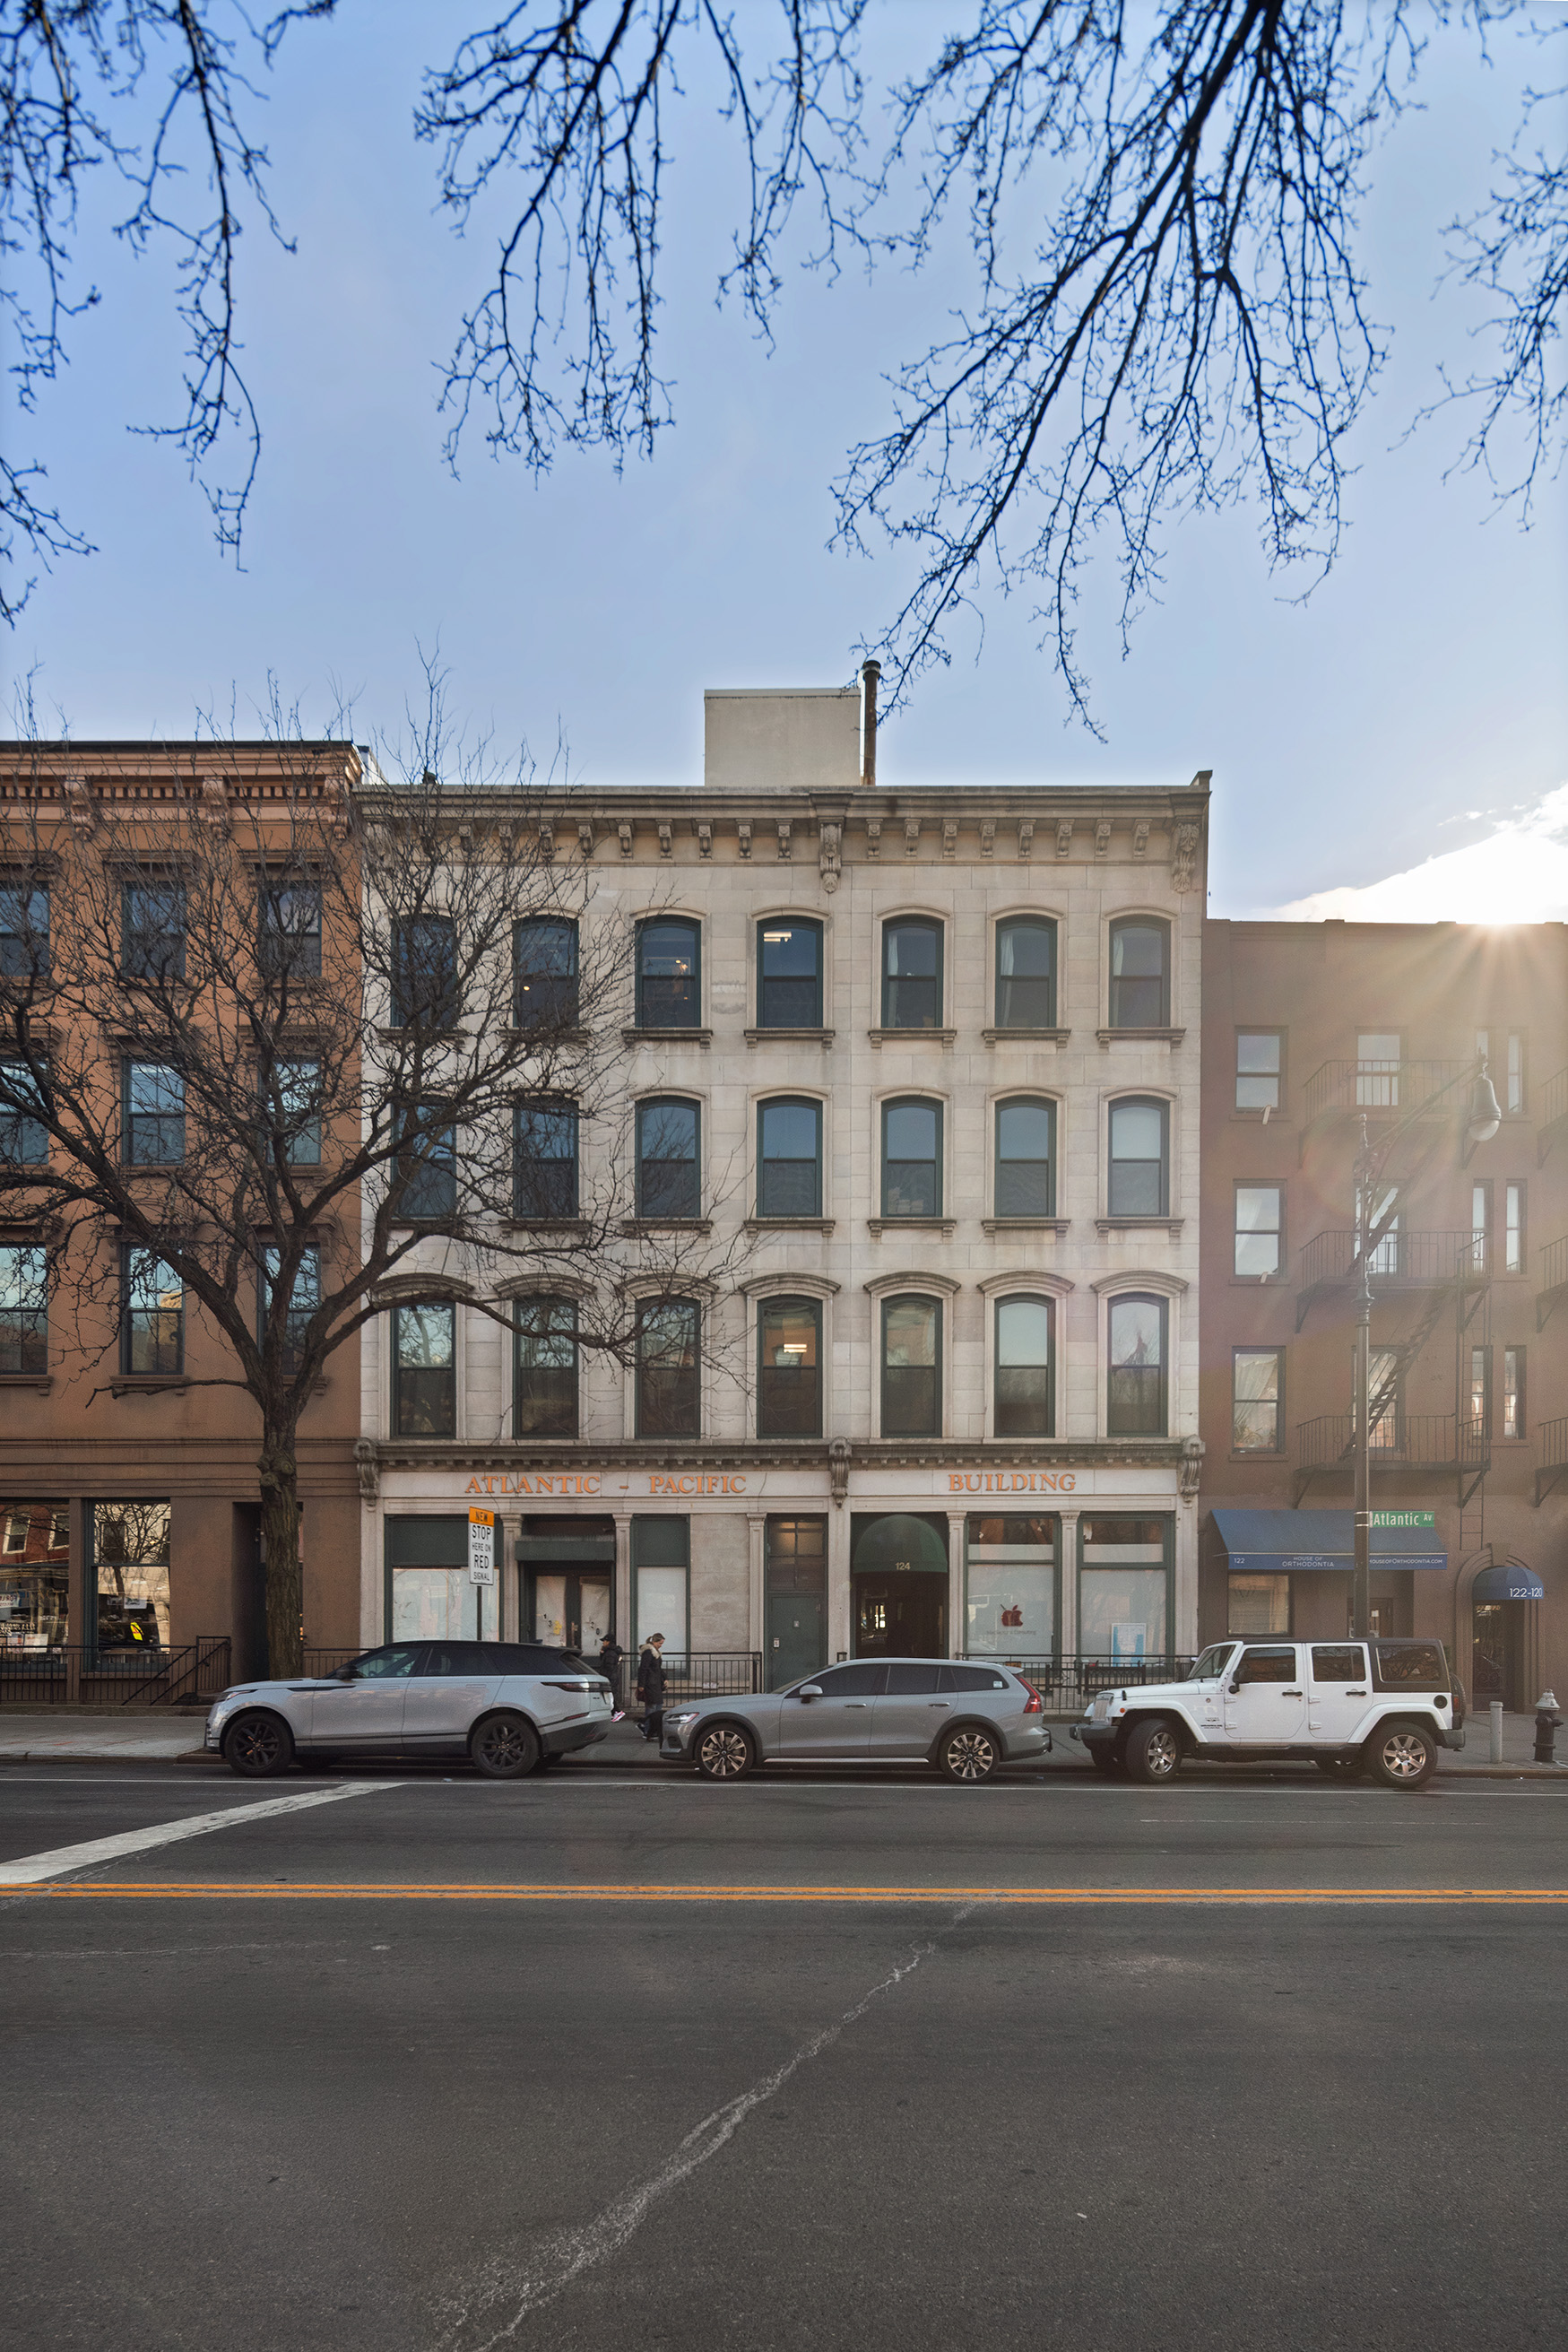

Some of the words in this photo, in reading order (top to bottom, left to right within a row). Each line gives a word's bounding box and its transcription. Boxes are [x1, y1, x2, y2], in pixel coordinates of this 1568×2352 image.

[464, 1475, 601, 1493] ATLANTIC
[649, 1475, 747, 1493] PACIFIC
[948, 1472, 1076, 1492] BUILDING
[475, 1511, 488, 1523] NEW
[1373, 1512, 1419, 1526] Atlantic
[1423, 1514, 1433, 1522] Av
[472, 1524, 491, 1541] STOP
[472, 1541, 484, 1552] HERE
[485, 1543, 491, 1553] ON
[473, 1554, 489, 1569] RED
[895, 1561, 911, 1570] 124
[473, 1571, 490, 1582] SIGNAL
[1509, 1587, 1543, 1598] 122-120
